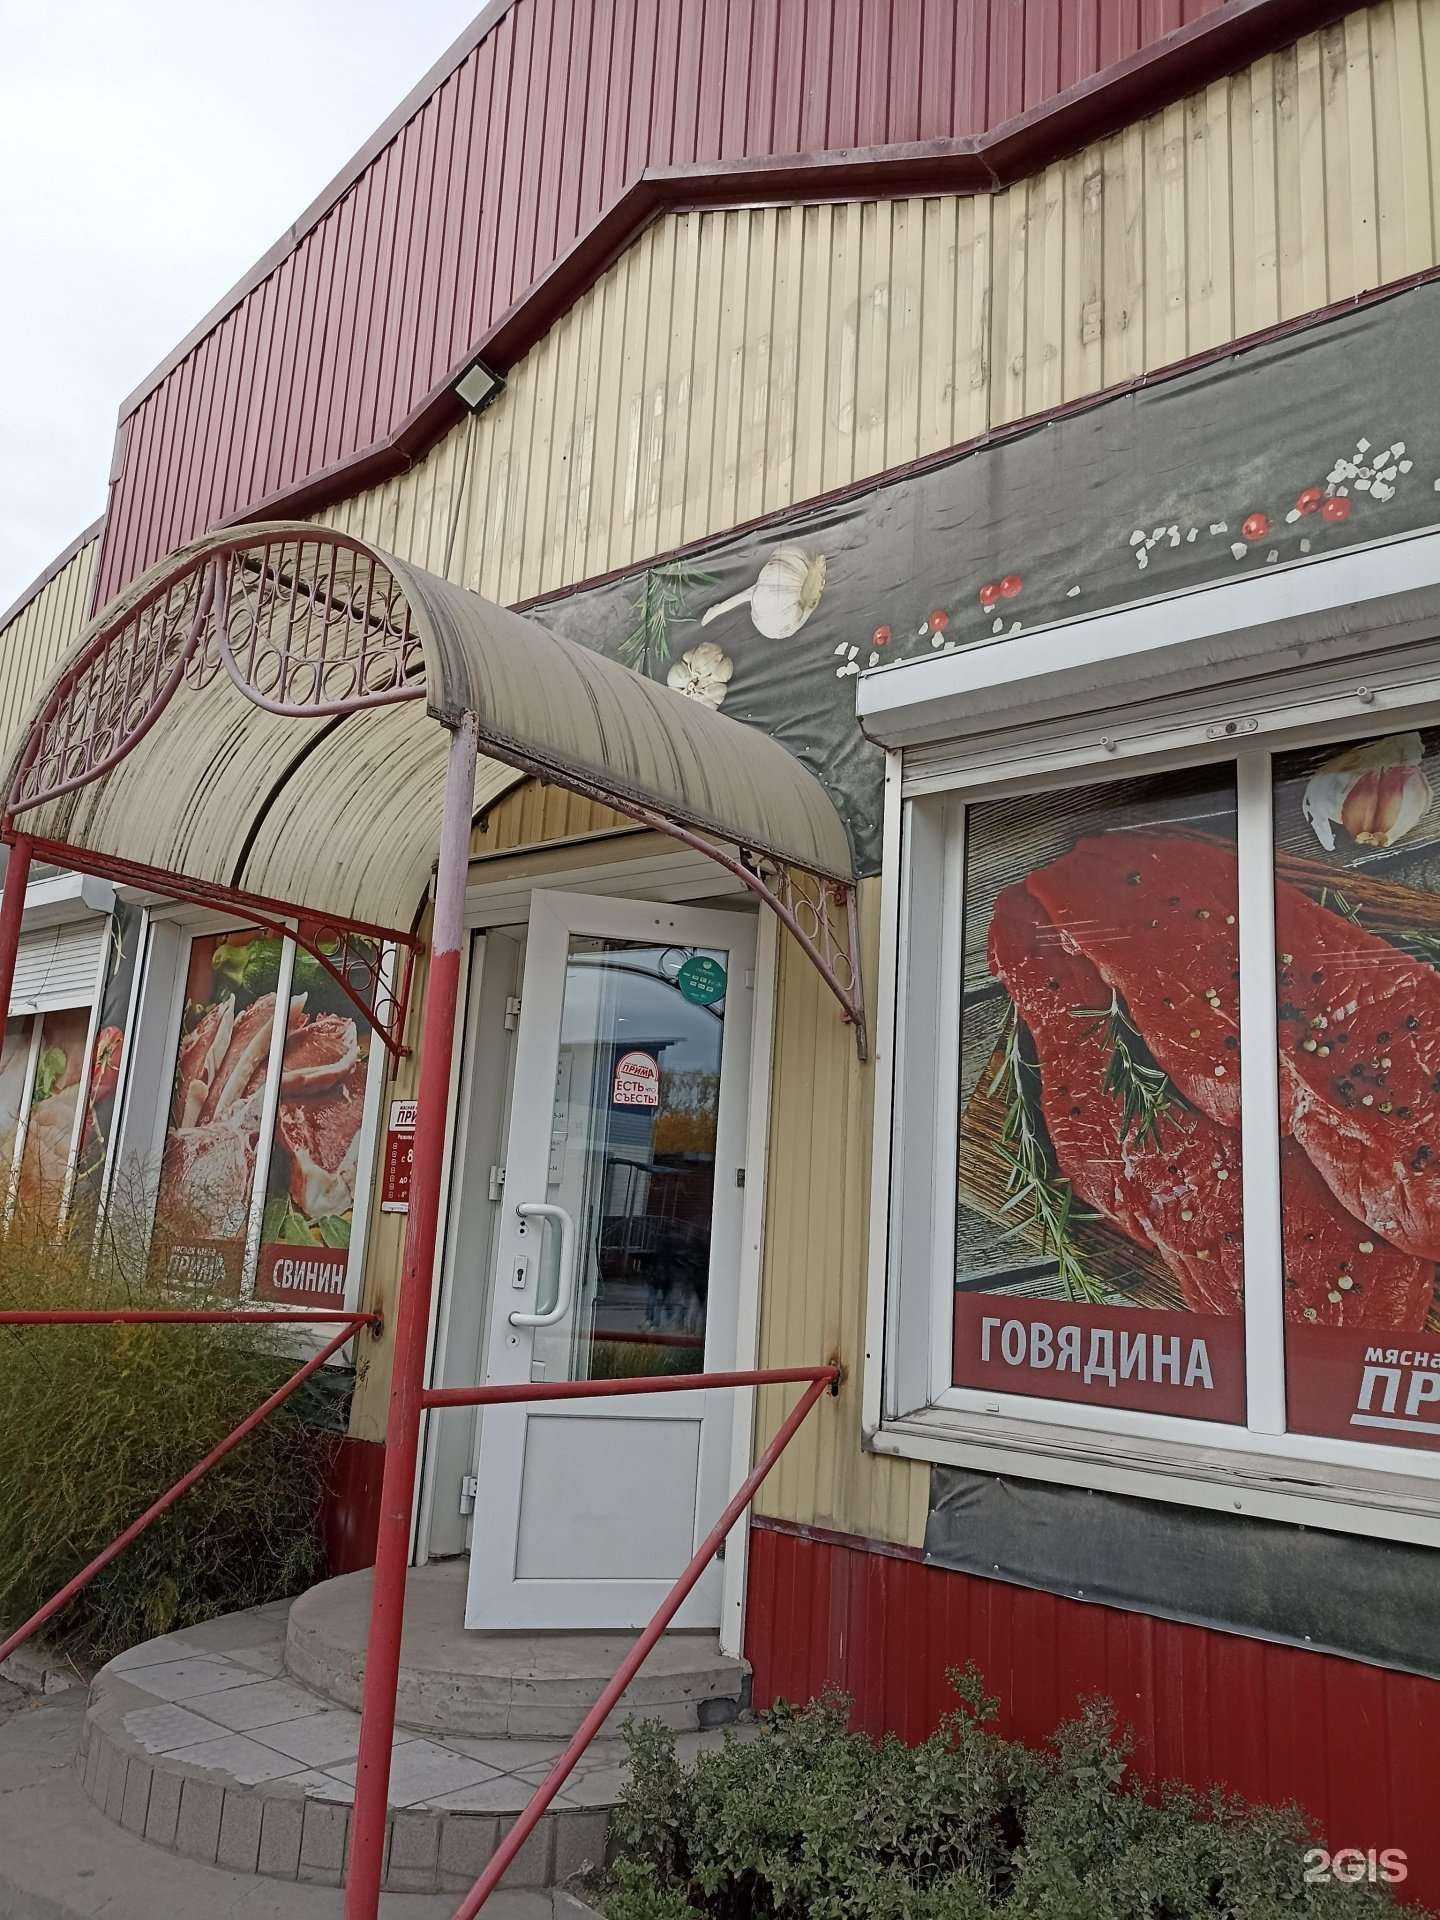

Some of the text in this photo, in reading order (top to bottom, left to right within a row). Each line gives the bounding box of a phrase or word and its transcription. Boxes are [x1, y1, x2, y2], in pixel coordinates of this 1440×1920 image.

[622, 1064, 655, 1079] ПРИМА
[616, 1080, 645, 1092] ЕСТЬ
[615, 1093, 657, 1104] СЪЕСТЬ!
[272, 1258, 345, 1295] СВИНИН
[981, 1316, 1214, 1389] ГОВЯДИНА
